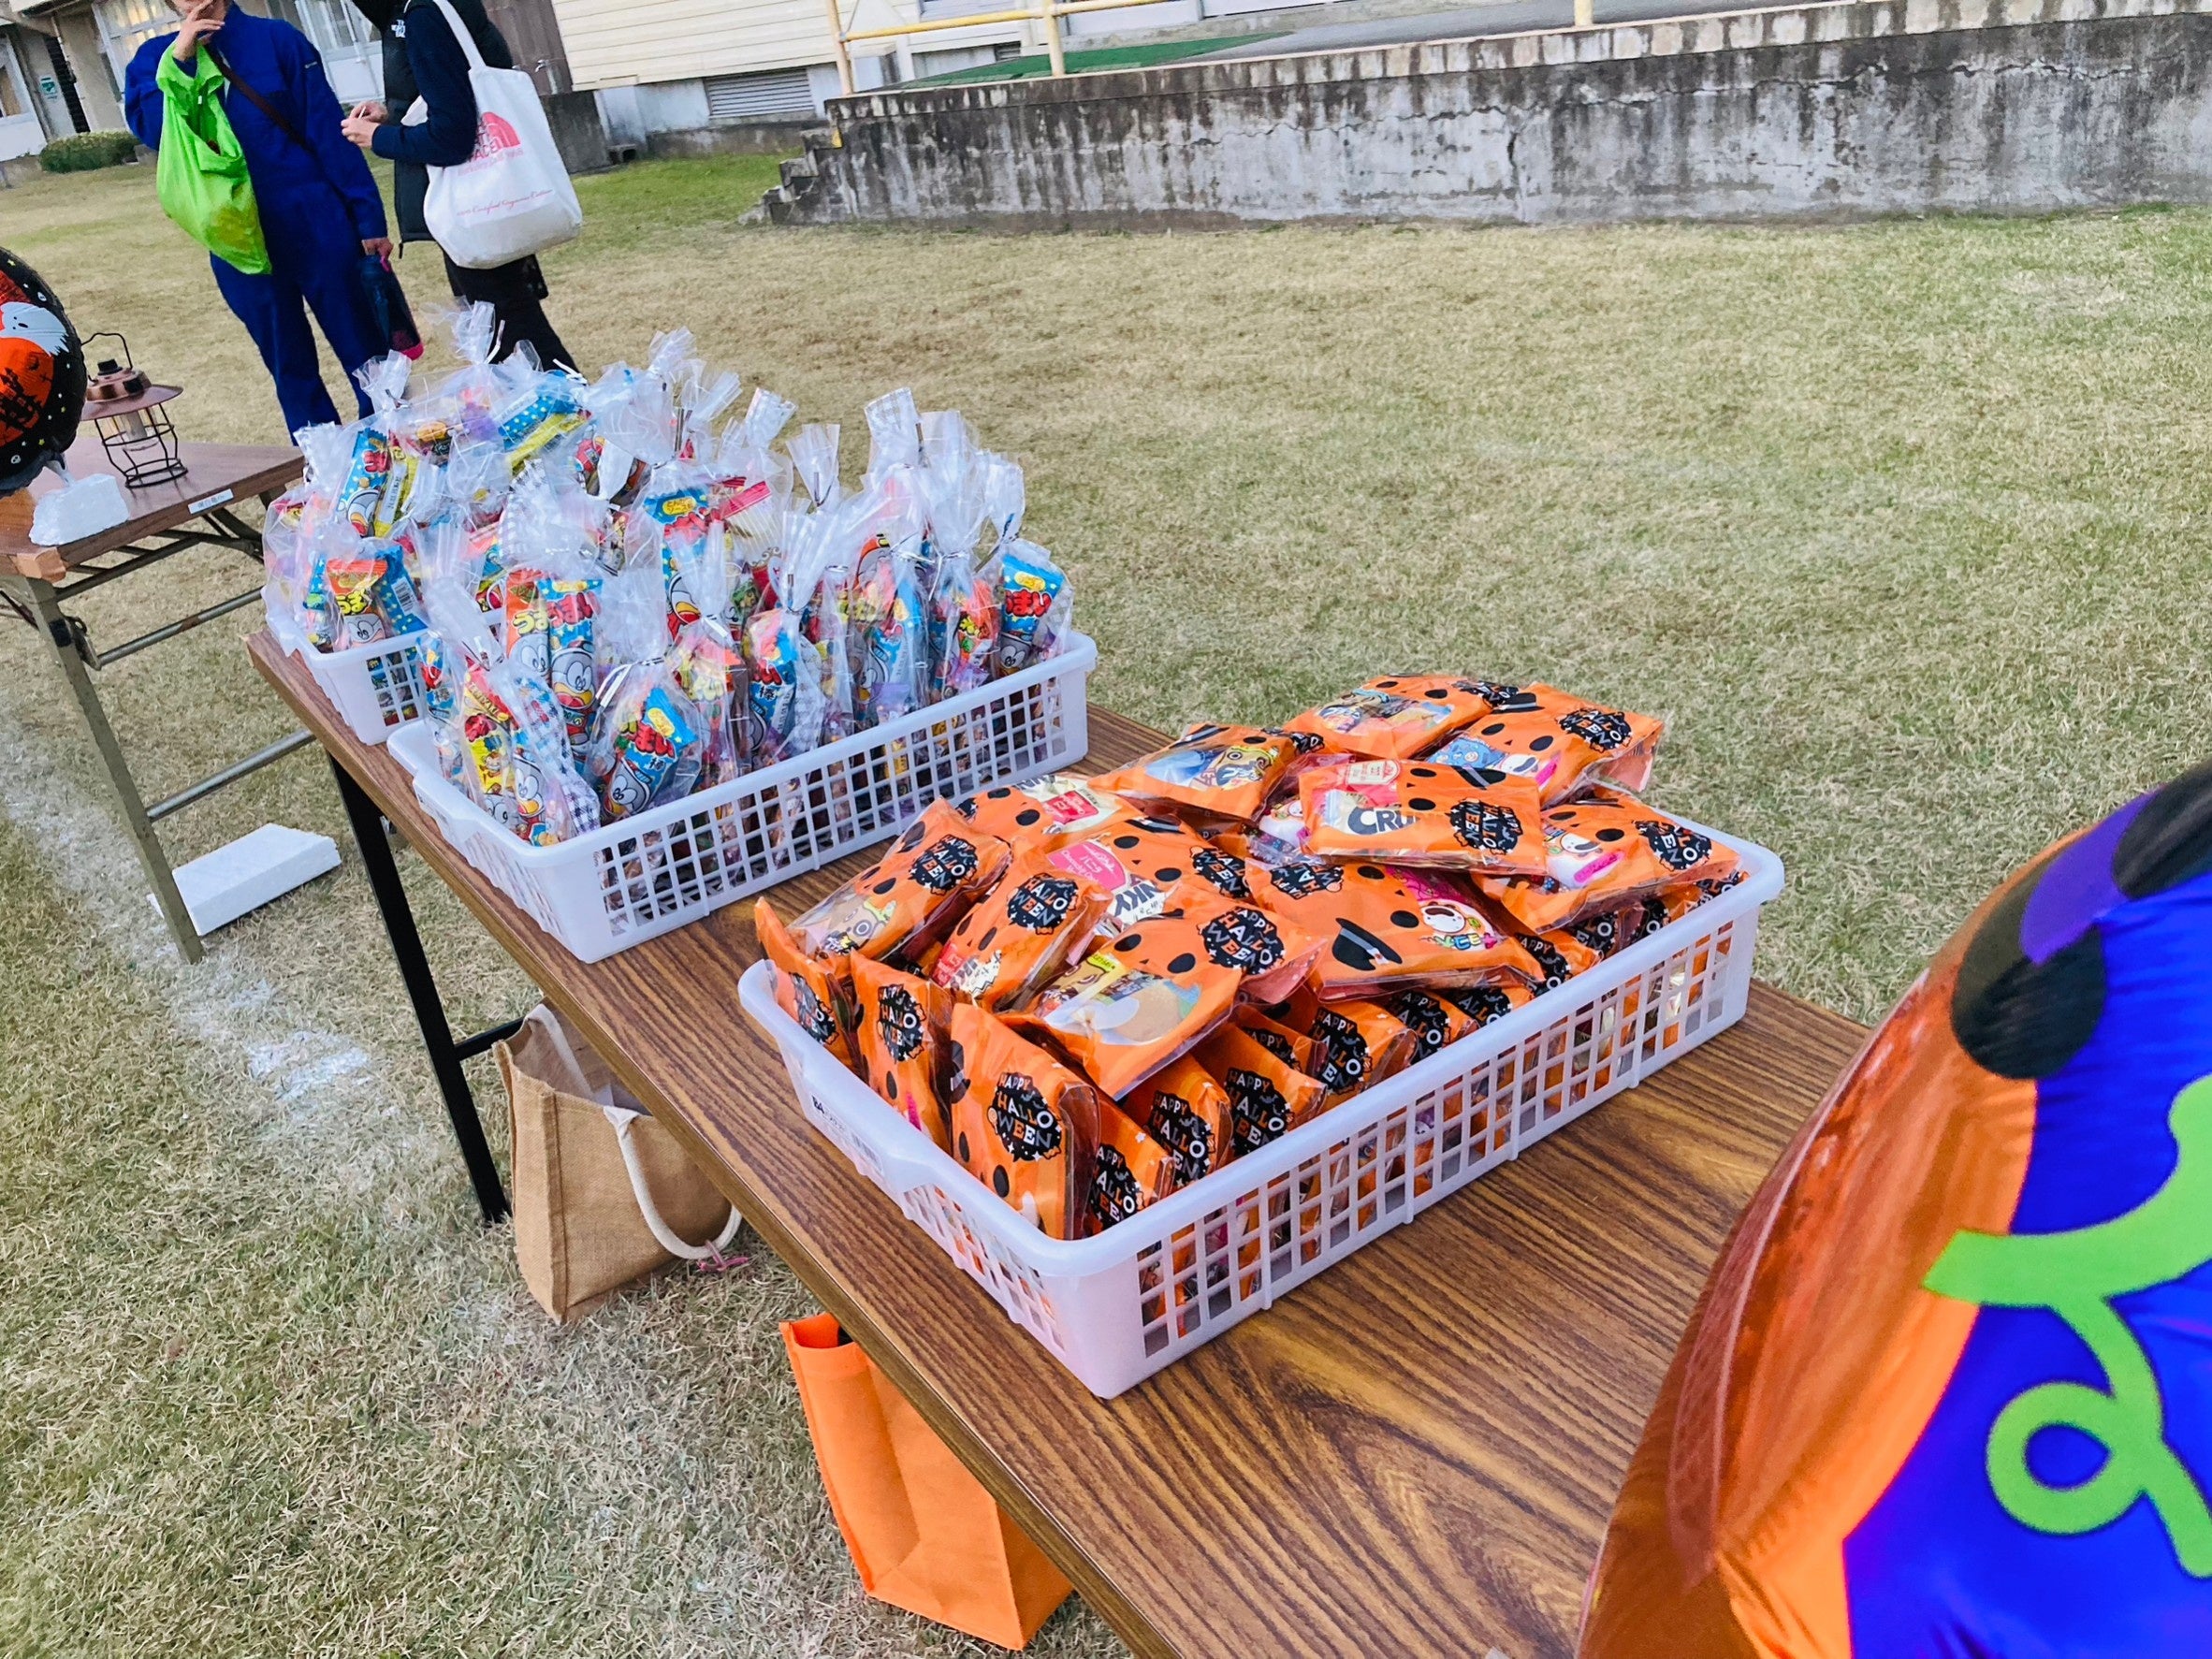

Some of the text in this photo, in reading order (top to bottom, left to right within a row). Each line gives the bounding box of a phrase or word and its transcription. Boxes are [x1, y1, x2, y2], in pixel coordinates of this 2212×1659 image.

[470, 138, 499, 161] ACE
[930, 843, 966, 876] HALLO
[1012, 890, 1055, 925] WEEN
[1024, 880, 1068, 910] HALLO
[1218, 914, 1273, 965] HALLO
[880, 1005, 917, 1028] HALLO
[1317, 1010, 1355, 1035] HAPPY
[999, 1075, 1031, 1091] HAPPY
[997, 1092, 1054, 1129] HALLO
[997, 1111, 1052, 1149] WEEN
[1152, 1110, 1205, 1158] HALLO
[1096, 1146, 1123, 1169] APPY
